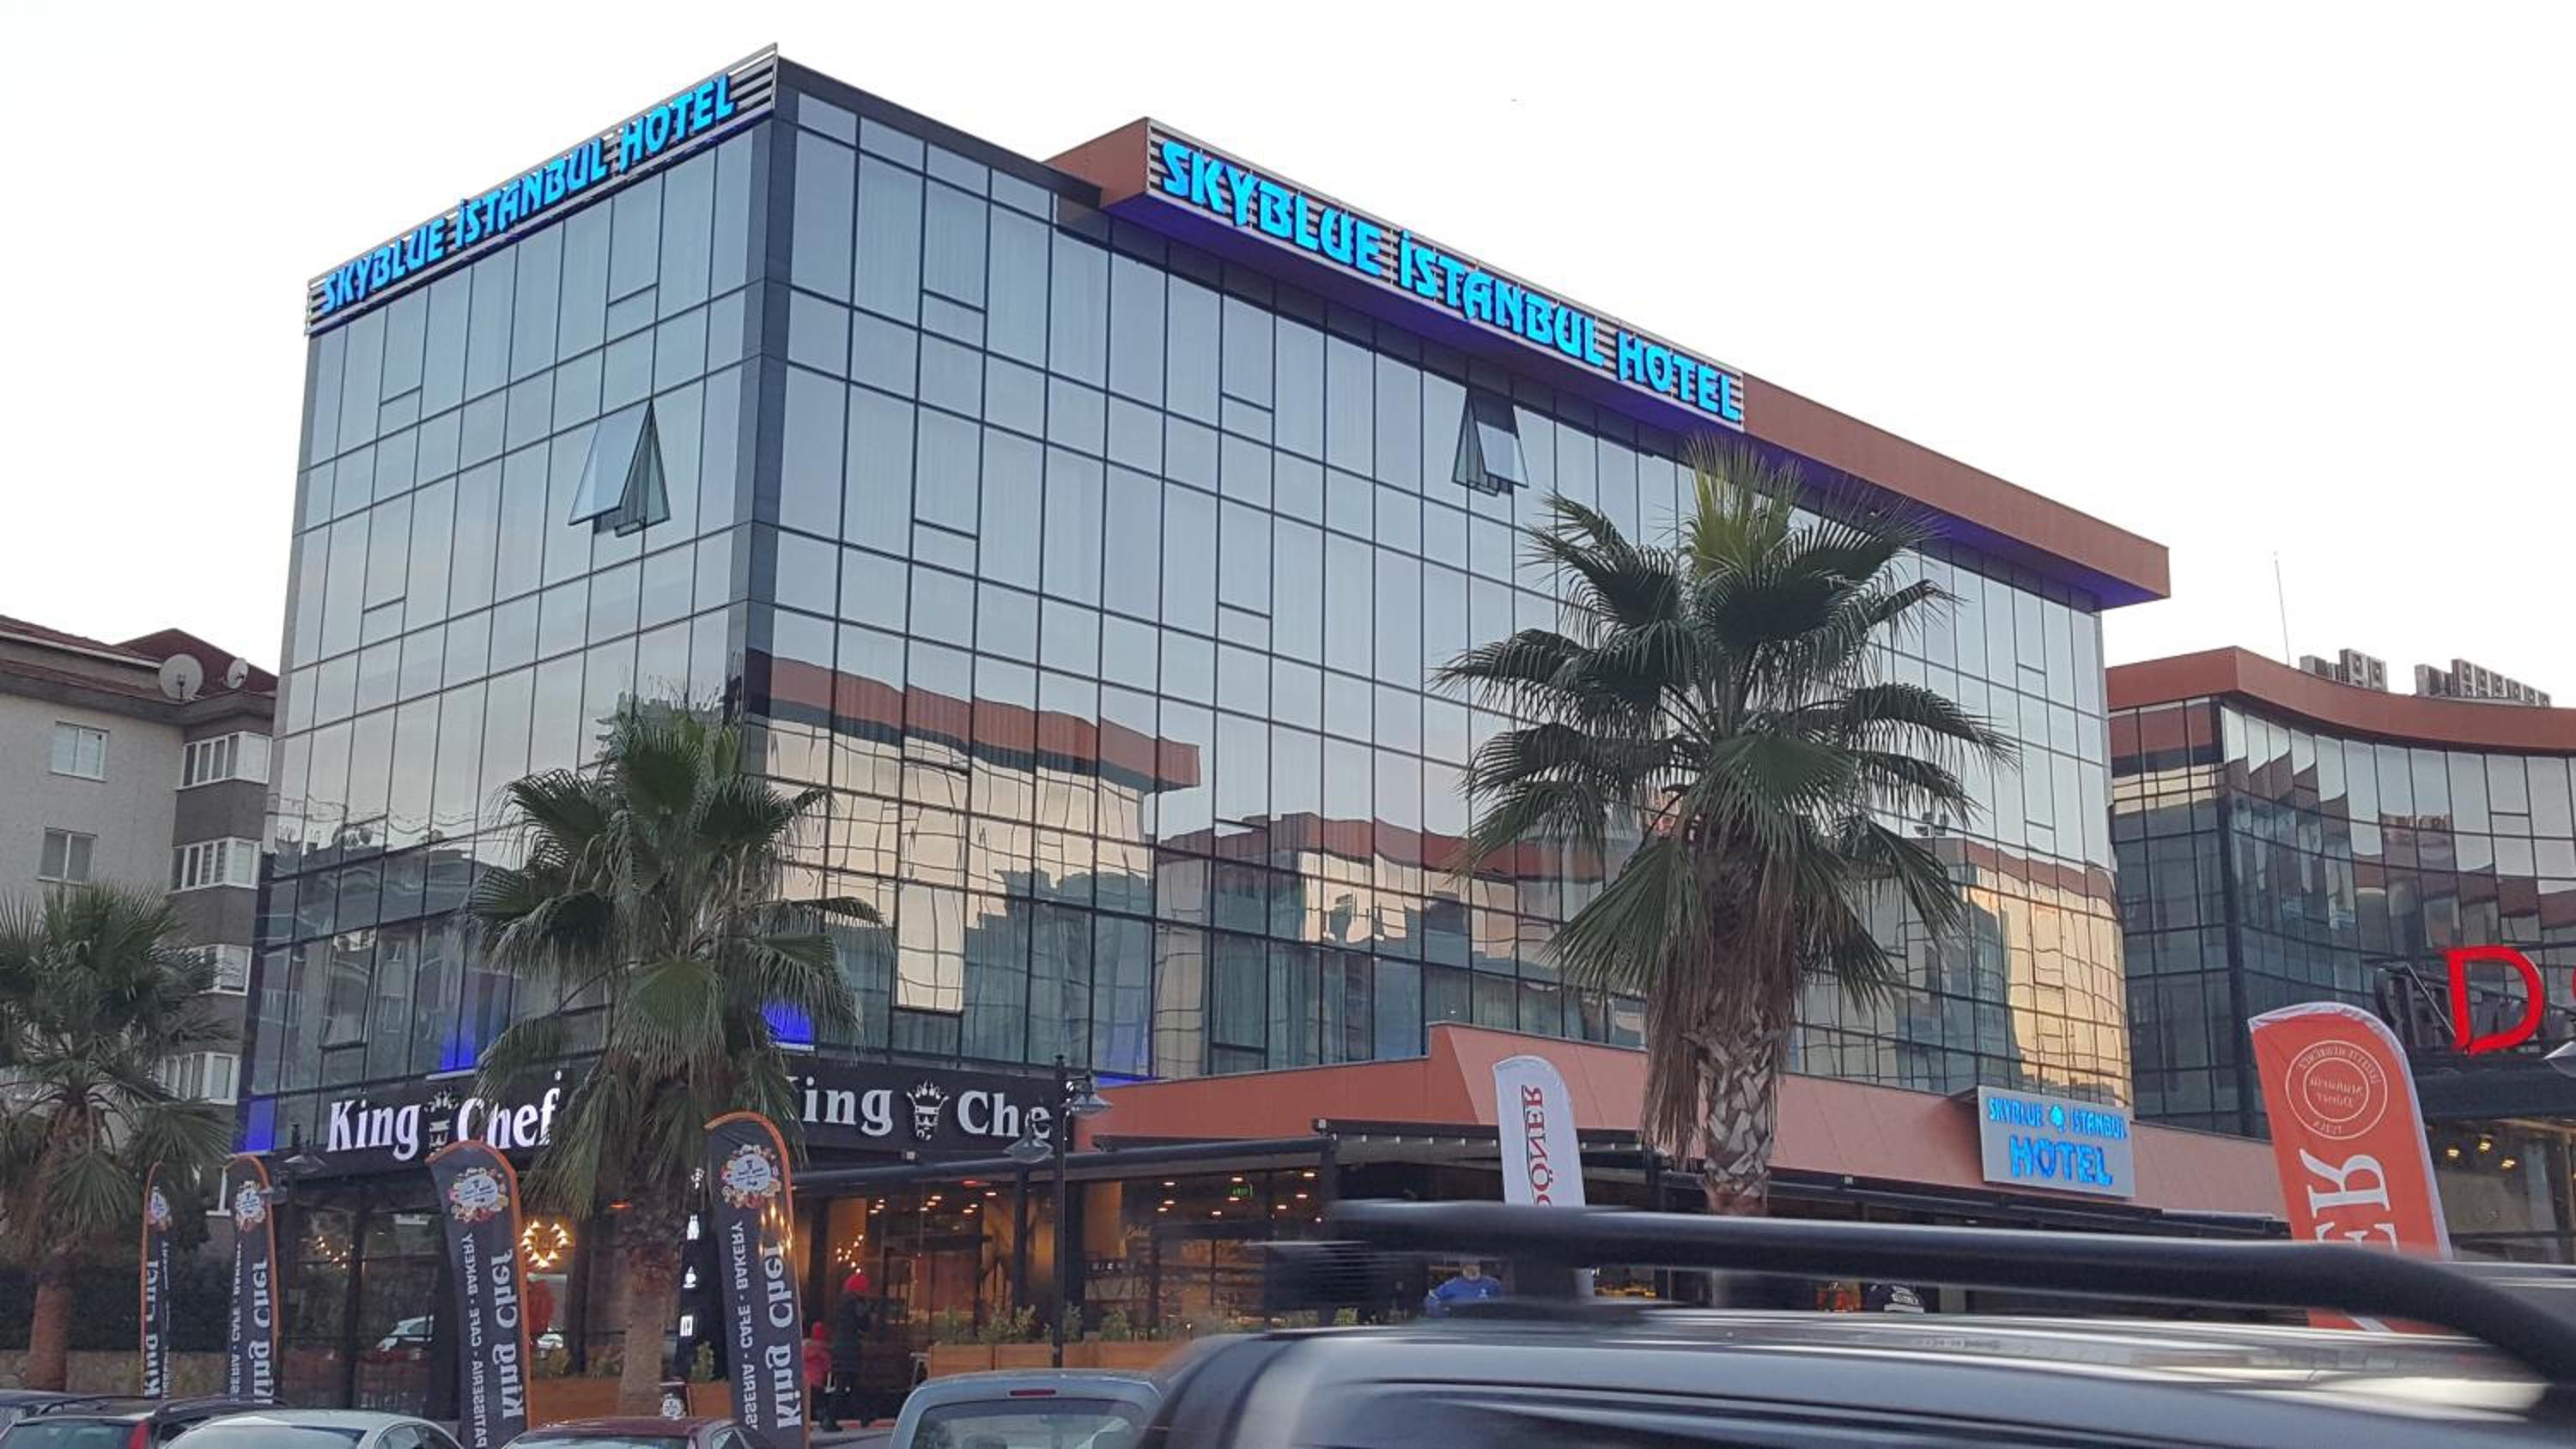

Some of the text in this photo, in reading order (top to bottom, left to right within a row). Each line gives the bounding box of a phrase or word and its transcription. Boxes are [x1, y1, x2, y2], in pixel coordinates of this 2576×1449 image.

[321, 216, 447, 314] SKYBLUE
[618, 74, 736, 174] HOTEL
[1161, 139, 1383, 277] SKYBLUE
[1617, 330, 1742, 422] HOTEL
[326, 1099, 422, 1161] King
[787, 1076, 1068, 1139] ing Che
[1987, 1097, 2044, 1128] SKYBLUE
[2009, 1134, 2114, 1187] HOTEL
